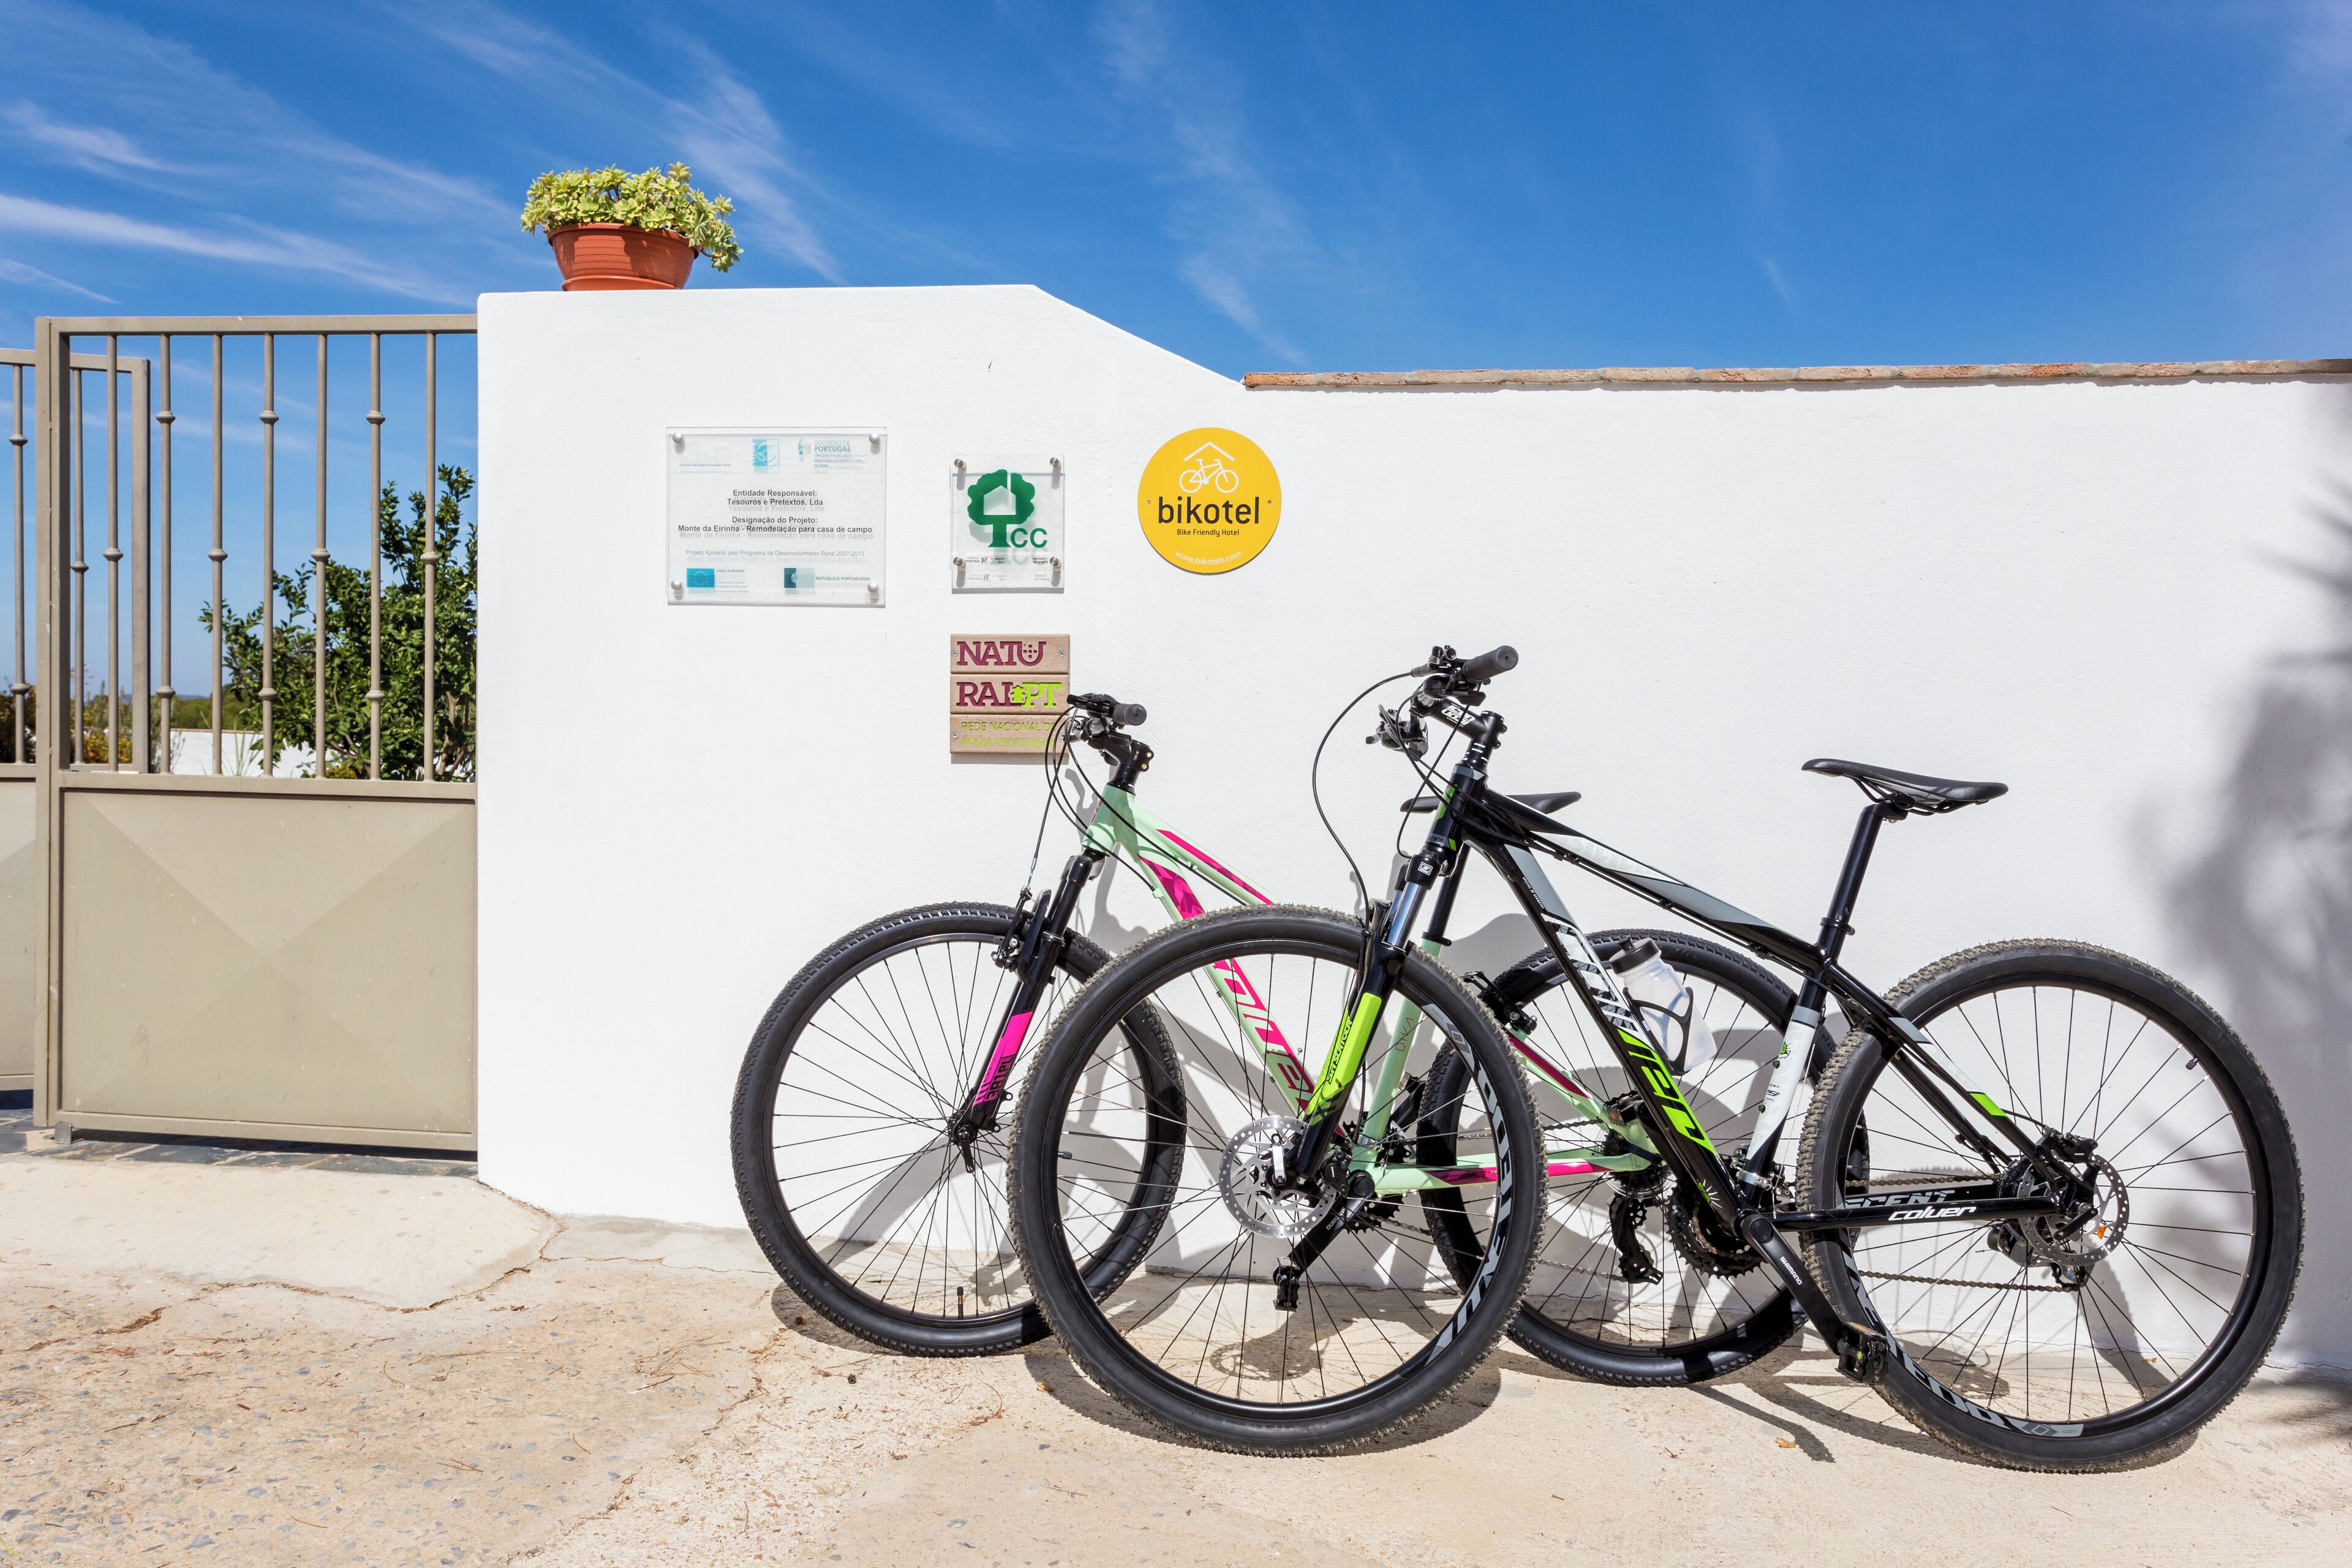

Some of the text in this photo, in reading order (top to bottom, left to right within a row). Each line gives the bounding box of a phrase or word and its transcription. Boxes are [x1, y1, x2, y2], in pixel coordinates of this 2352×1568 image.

[1158, 496, 1259, 524] bikotel
[1193, 529, 1220, 538] Friendly
[1175, 551, 1242, 565] www.bikotels.com
[957, 641, 1047, 666] NATU
[961, 722, 987, 731] REDE
[989, 722, 1041, 731] NACIONAL
[1779, 1256, 1803, 1286] SHIMANO
